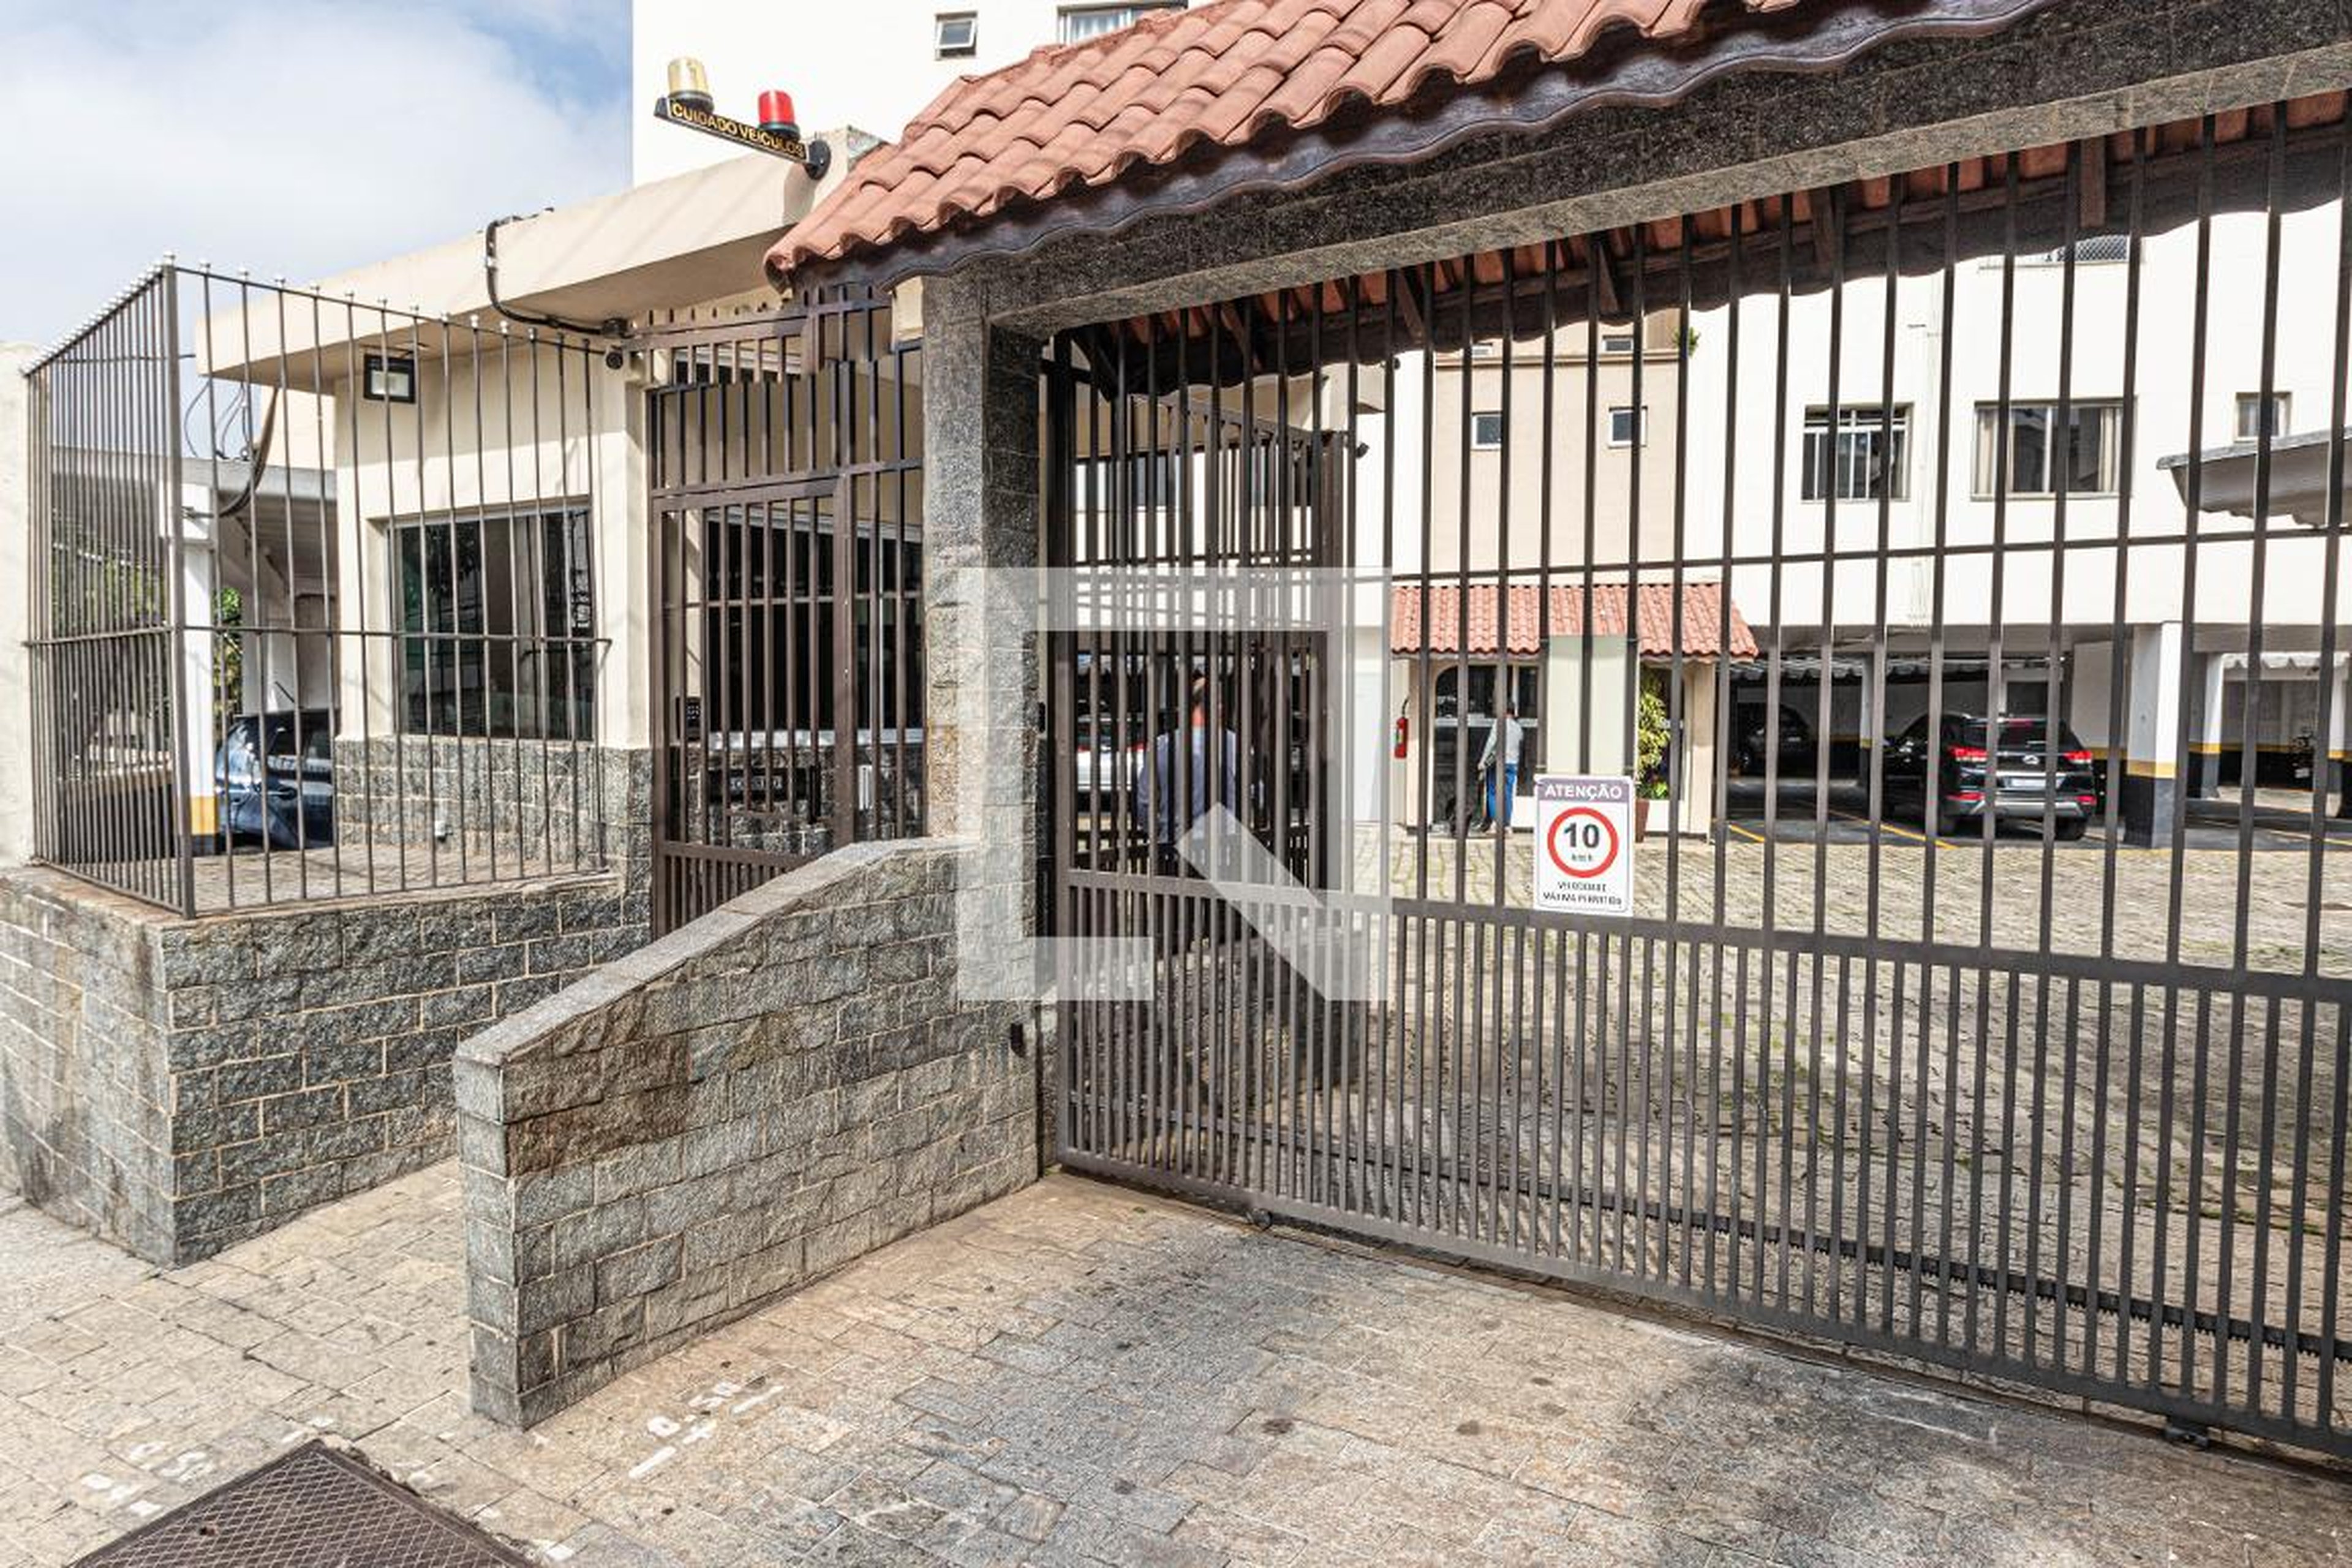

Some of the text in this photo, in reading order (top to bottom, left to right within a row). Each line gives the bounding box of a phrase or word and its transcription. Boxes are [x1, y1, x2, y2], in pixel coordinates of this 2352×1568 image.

[673, 102, 737, 135] CUIDADO
[1544, 783, 1623, 800] ATENÇÃO
[1564, 822, 1600, 849] 10
